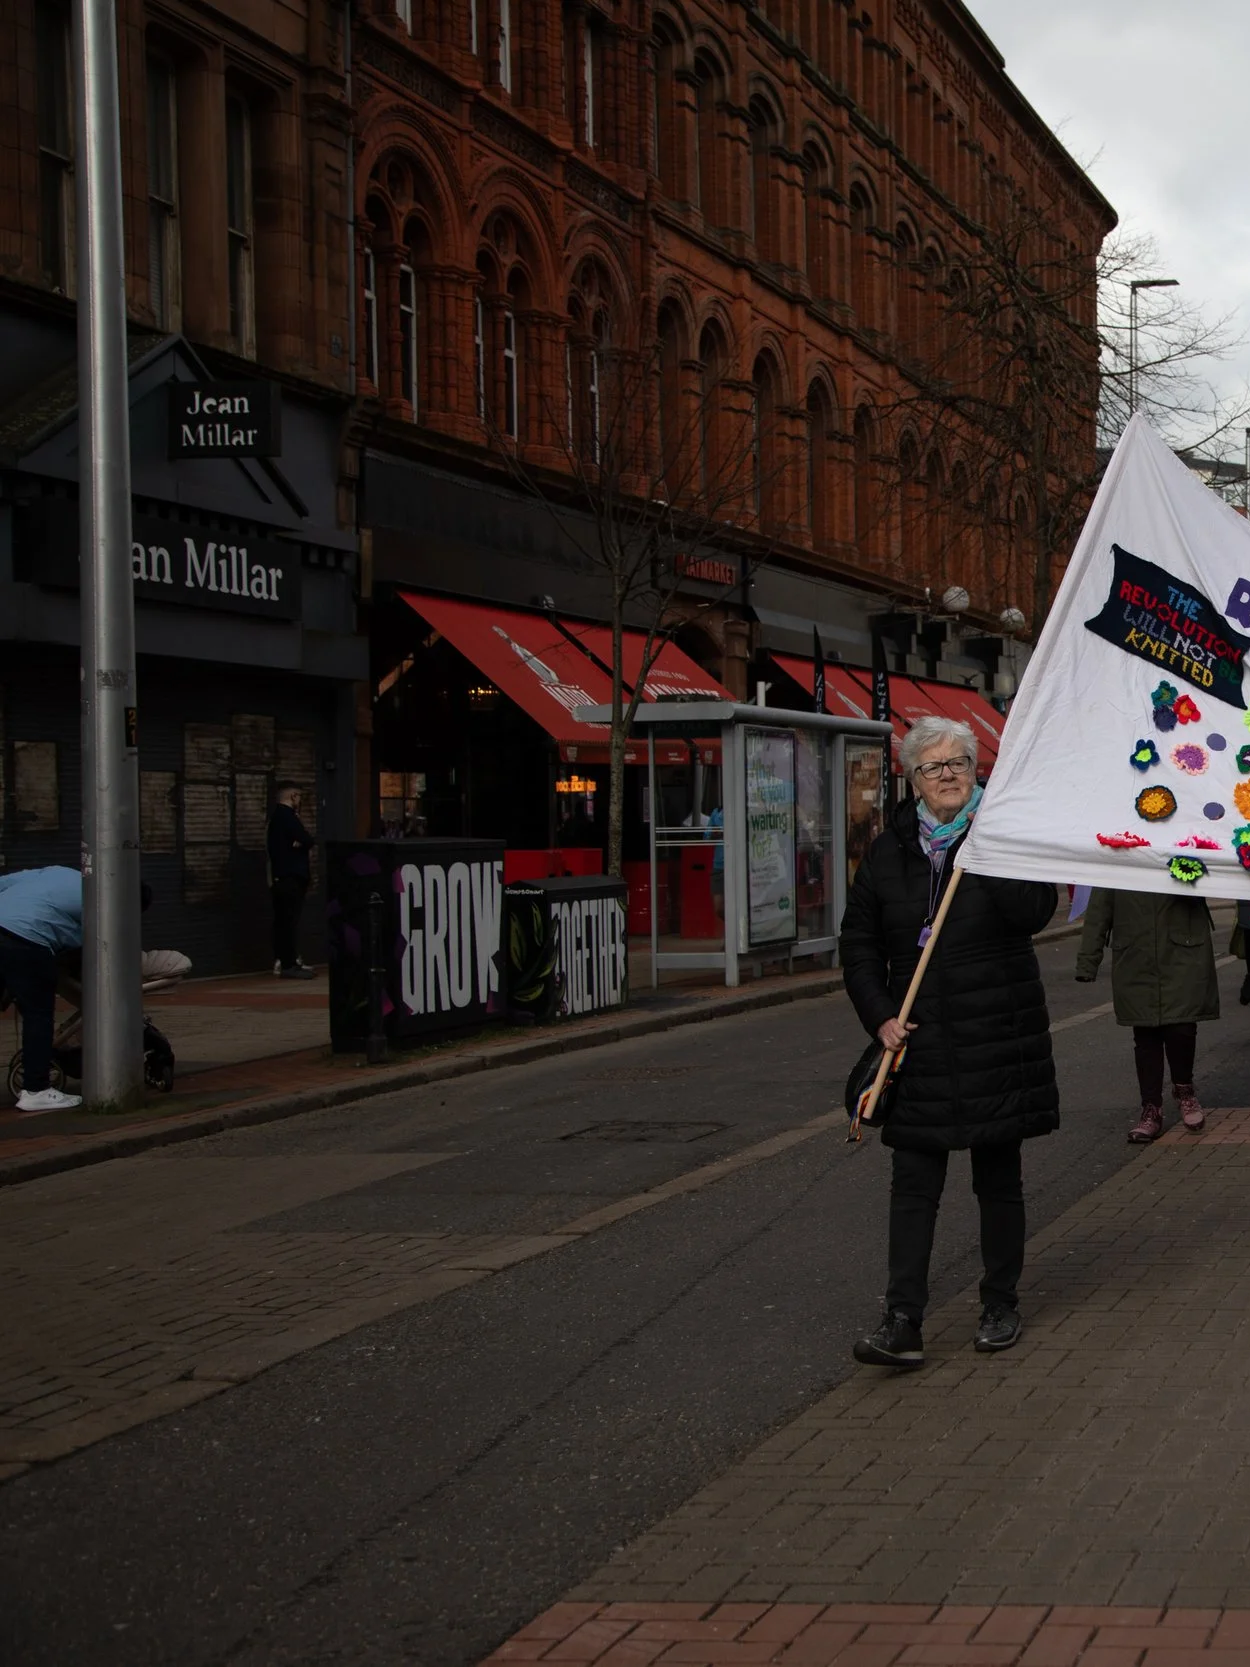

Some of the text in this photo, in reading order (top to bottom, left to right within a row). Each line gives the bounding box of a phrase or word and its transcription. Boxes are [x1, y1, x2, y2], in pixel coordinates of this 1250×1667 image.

[186, 391, 250, 415] Jean
[181, 423, 258, 447] Millar
[183, 537, 283, 601] Millar
[1119, 580, 1242, 664] REVOLUTION
[1168, 585, 1204, 621] THE
[1123, 603, 1241, 684] WILL NOT BE
[1124, 627, 1214, 688] KNITTED
[751, 811, 788, 834] waiting
[400, 860, 504, 1016] GROW
[550, 896, 627, 1019] TOGETHER
